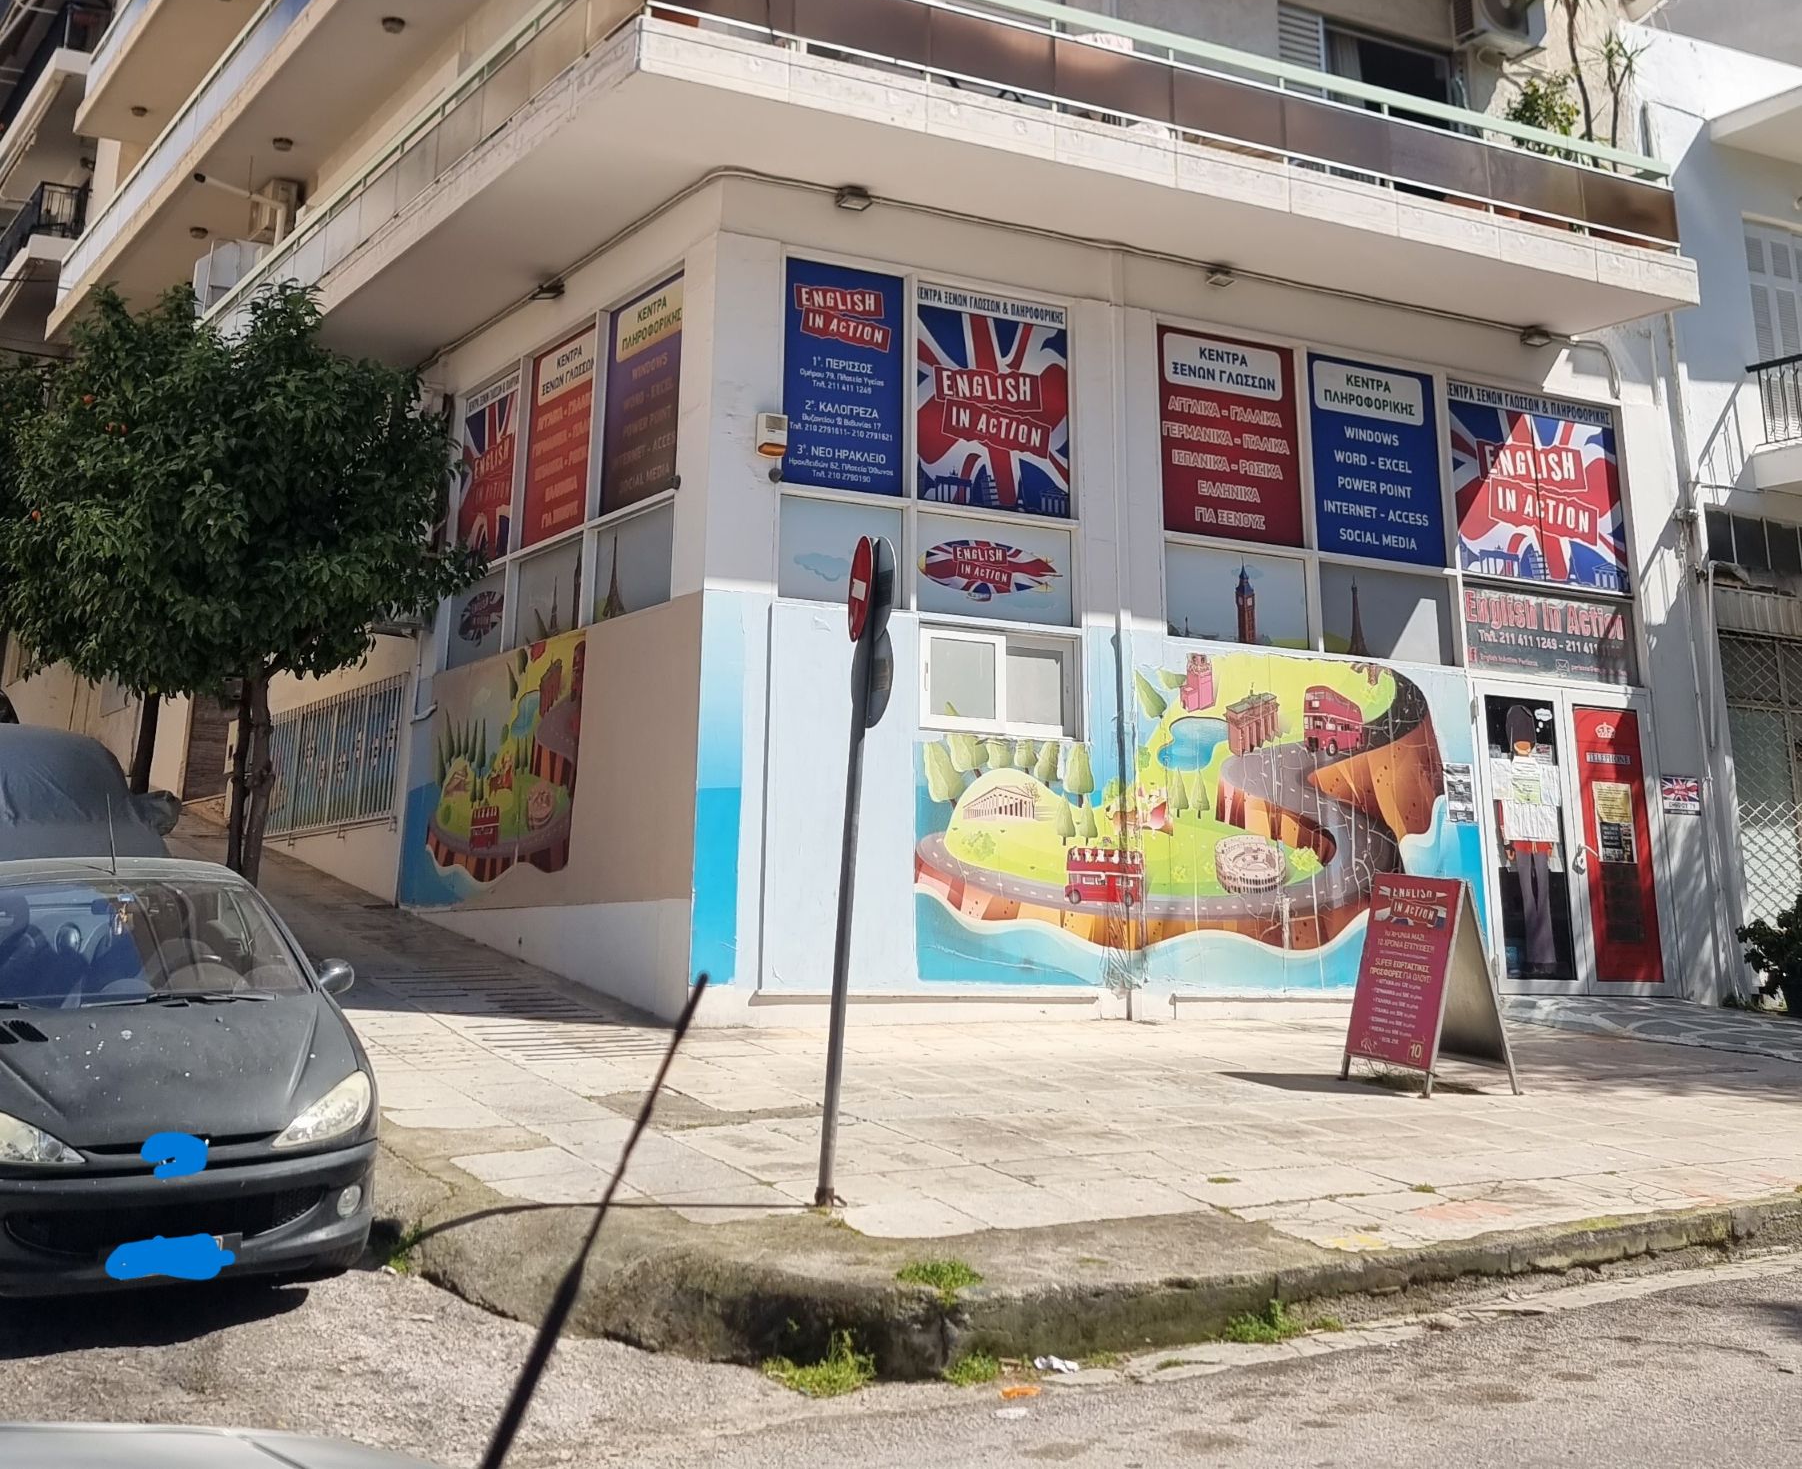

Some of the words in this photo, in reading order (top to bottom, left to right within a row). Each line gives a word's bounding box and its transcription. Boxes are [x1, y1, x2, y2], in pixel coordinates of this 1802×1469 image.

[637, 295, 668, 323] ΚΕΝΤΡΑ
[801, 287, 875, 311] ENGLISH
[944, 291, 968, 307] ΞΕΝΩΝ
[969, 295, 1000, 312] ΓΛΩΣΣΩΝ
[1002, 302, 1009, 315] &
[1011, 303, 1064, 325] ΠΛΗΡΟΦΟΡΙΚΗΣ
[622, 307, 682, 351] ΠΛΗΡΟΦΟΡΙΚΗΣ
[808, 312, 824, 329] IN
[556, 344, 583, 368] ΚΕΝΤΡΑ
[825, 358, 873, 374] ΠΕΡΙΣΣΟΣ
[1199, 346, 1248, 367] ΚΕΝΤΡΑ
[827, 381, 840, 390] 211
[942, 370, 1031, 402] ENGLISH
[1172, 361, 1216, 381] ΞΕΝΩΝ
[1219, 370, 1276, 392] ΓΛΩΣΣΩΝ
[1345, 373, 1391, 393] ΚΕΝΤΡΑ
[819, 401, 879, 419] ΚΑΛΟΓΡΕΖΑ
[1167, 395, 1221, 418] ΑΓΓΛΙΚΑ
[1229, 405, 1283, 428] ΓΑΛΛΙΚΑ
[1324, 389, 1415, 416] ΠΛΗΡΟΦΟΡΙΚΗΣ
[1476, 388, 1502, 404] ΞΕΝΩΝ
[1505, 393, 1540, 413] ΓΛΩΣΣΩΝ
[1542, 401, 1548, 413] &
[1551, 402, 1611, 425] ΠΛΗΡΟΦΟΡΙΚΗΣ
[951, 406, 970, 428] IN
[804, 423, 817, 432] 210
[851, 429, 865, 438] 210
[1162, 420, 1234, 446] ΓΕΡΜΑΝΙΚΑ
[1242, 433, 1291, 455] ΙΤΑΛΙΚΑ
[1344, 425, 1399, 447] WINDOWS
[811, 445, 832, 458] ΝΕΟ
[834, 448, 886, 465] ΗΡΑΚΛΕΙΟ
[1171, 449, 1231, 472] ΙΣΠΑΝΙΚΑ
[1239, 459, 1284, 480] ΡΩΣΙΚΑ
[1334, 450, 1368, 467] WORD
[1378, 457, 1413, 474] EXCEL
[1484, 445, 1576, 481] ENGLISH
[827, 471, 840, 479] 210
[1337, 475, 1377, 494] POWER
[1379, 482, 1412, 499] POINT
[1197, 479, 1261, 503] ΕΛΛΗΝΙΚΑ
[1497, 486, 1517, 512] IN
[1194, 506, 1217, 524] ΓΙΑ
[1217, 509, 1266, 530] ΞΕΝΟΥΣ
[1323, 499, 1378, 519] INTERNET
[1387, 509, 1429, 527] ACCESS
[1339, 527, 1380, 545] SOCIAL
[1382, 533, 1418, 551] MEDIA
[957, 547, 1003, 562] ENGLISH
[961, 563, 971, 575] IN
[1464, 589, 1538, 630] English
[1499, 631, 1516, 645] 211
[1517, 634, 1534, 648] 411
[1565, 640, 1582, 653] 211
[1394, 901, 1403, 913] IN
[1410, 1043, 1422, 1058] 10
